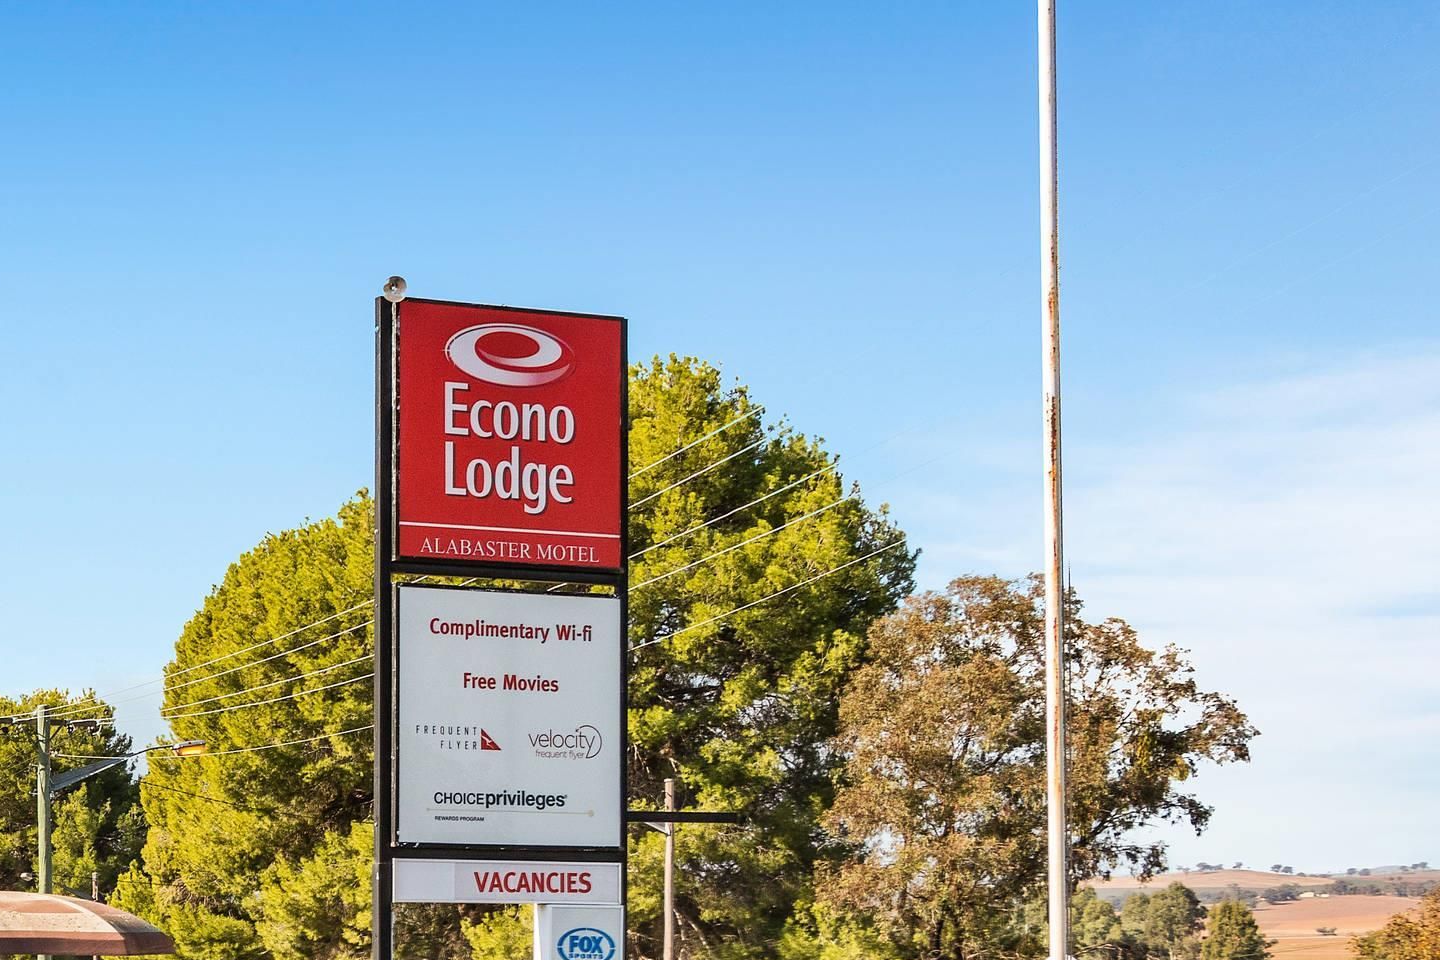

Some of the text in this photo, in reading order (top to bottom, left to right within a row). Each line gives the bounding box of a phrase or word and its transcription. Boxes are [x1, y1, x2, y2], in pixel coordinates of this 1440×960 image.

[444, 381, 575, 444] Econo
[444, 441, 574, 514] Lodge
[420, 537, 600, 564] ALABASTER MOTEL
[430, 617, 592, 643] Complimentary Wi-fi
[463, 672, 559, 692] Free Movies
[416, 724, 478, 736] FREQUENT
[528, 728, 596, 752] velocity
[440, 739, 477, 751] FLYER
[535, 749, 585, 761] frequent flyer
[474, 871, 592, 894] VACANCIES
[568, 935, 603, 954] FOX
[568, 952, 604, 960] SPORTS
